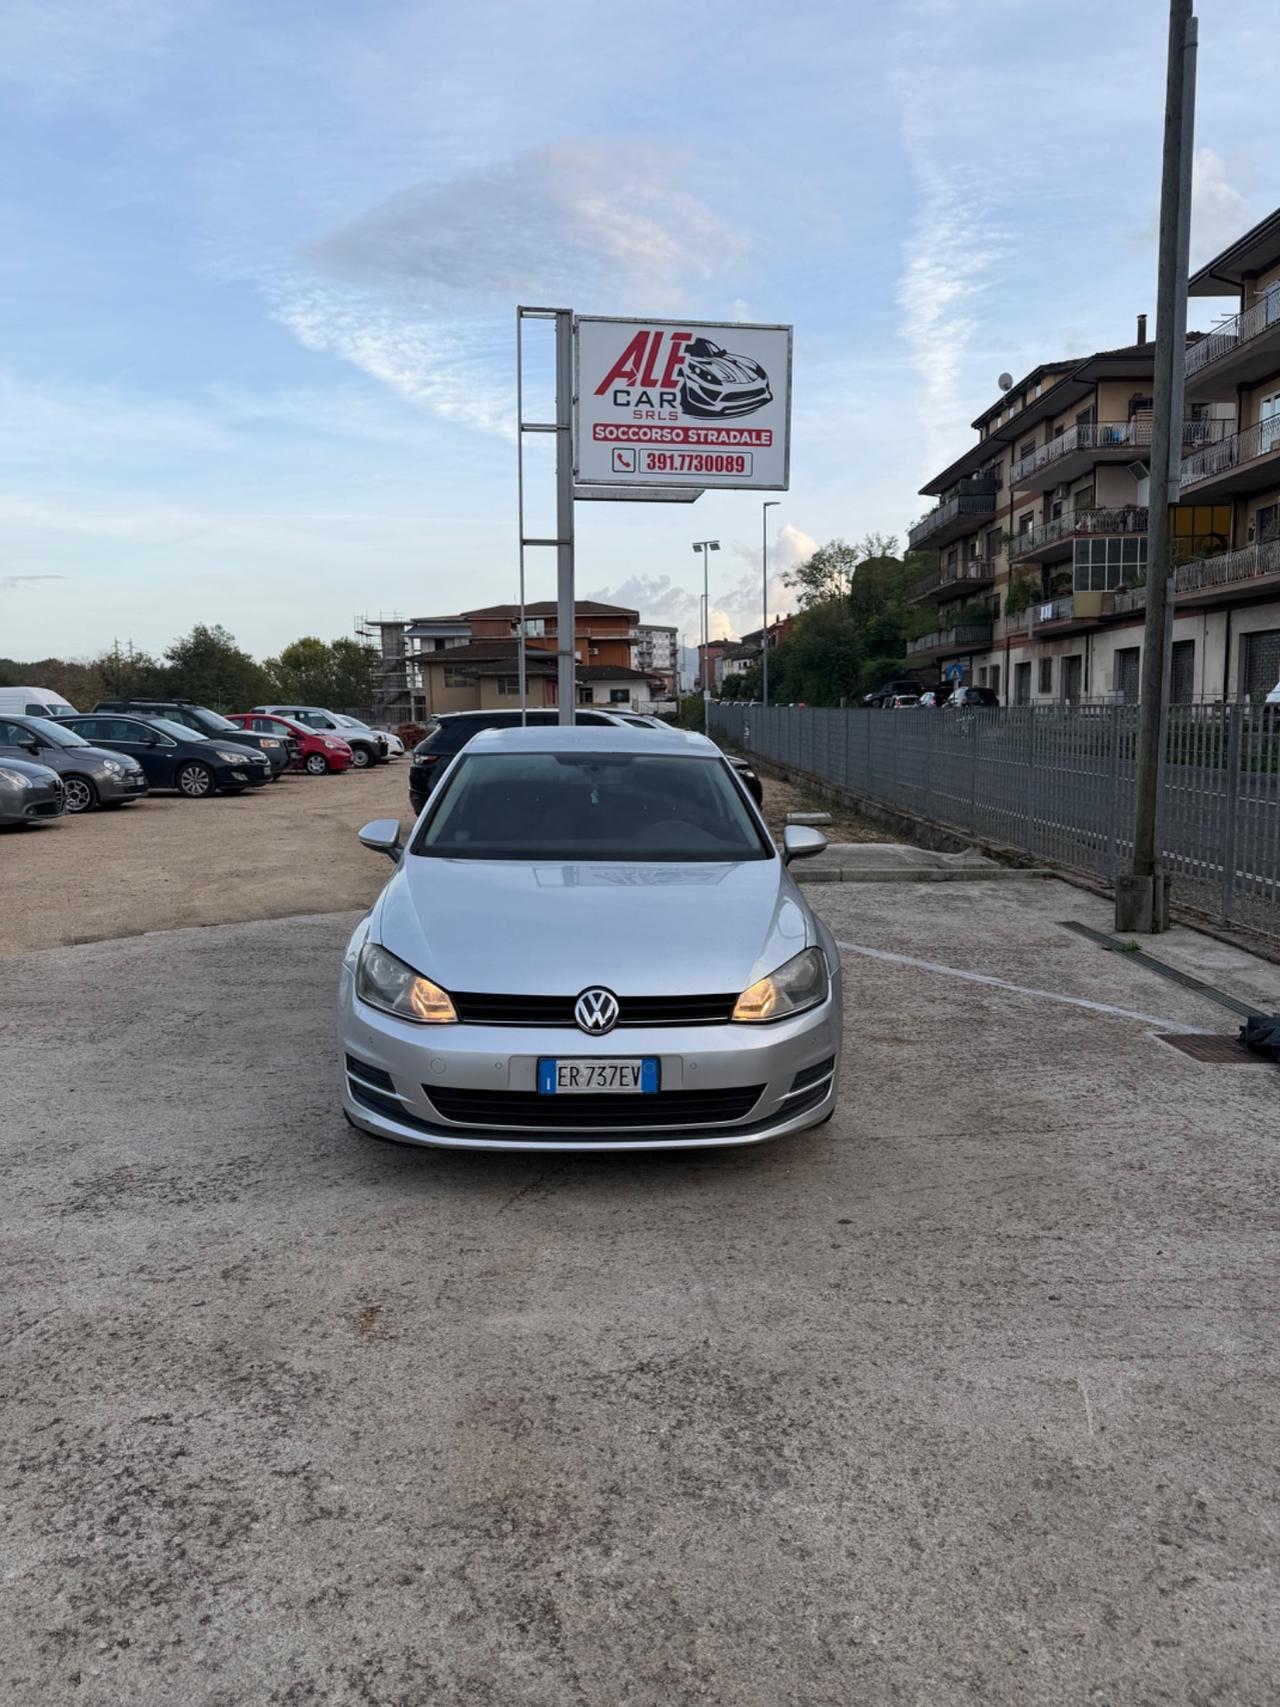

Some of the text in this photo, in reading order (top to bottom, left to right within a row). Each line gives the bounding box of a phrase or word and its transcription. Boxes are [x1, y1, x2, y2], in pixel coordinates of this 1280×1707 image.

[594, 331, 693, 395] ALE
[613, 389, 678, 409] CAR
[632, 409, 679, 421] SRLS
[595, 426, 771, 445] SOCCORSO STRADALE
[646, 452, 745, 473] 391.7730089
